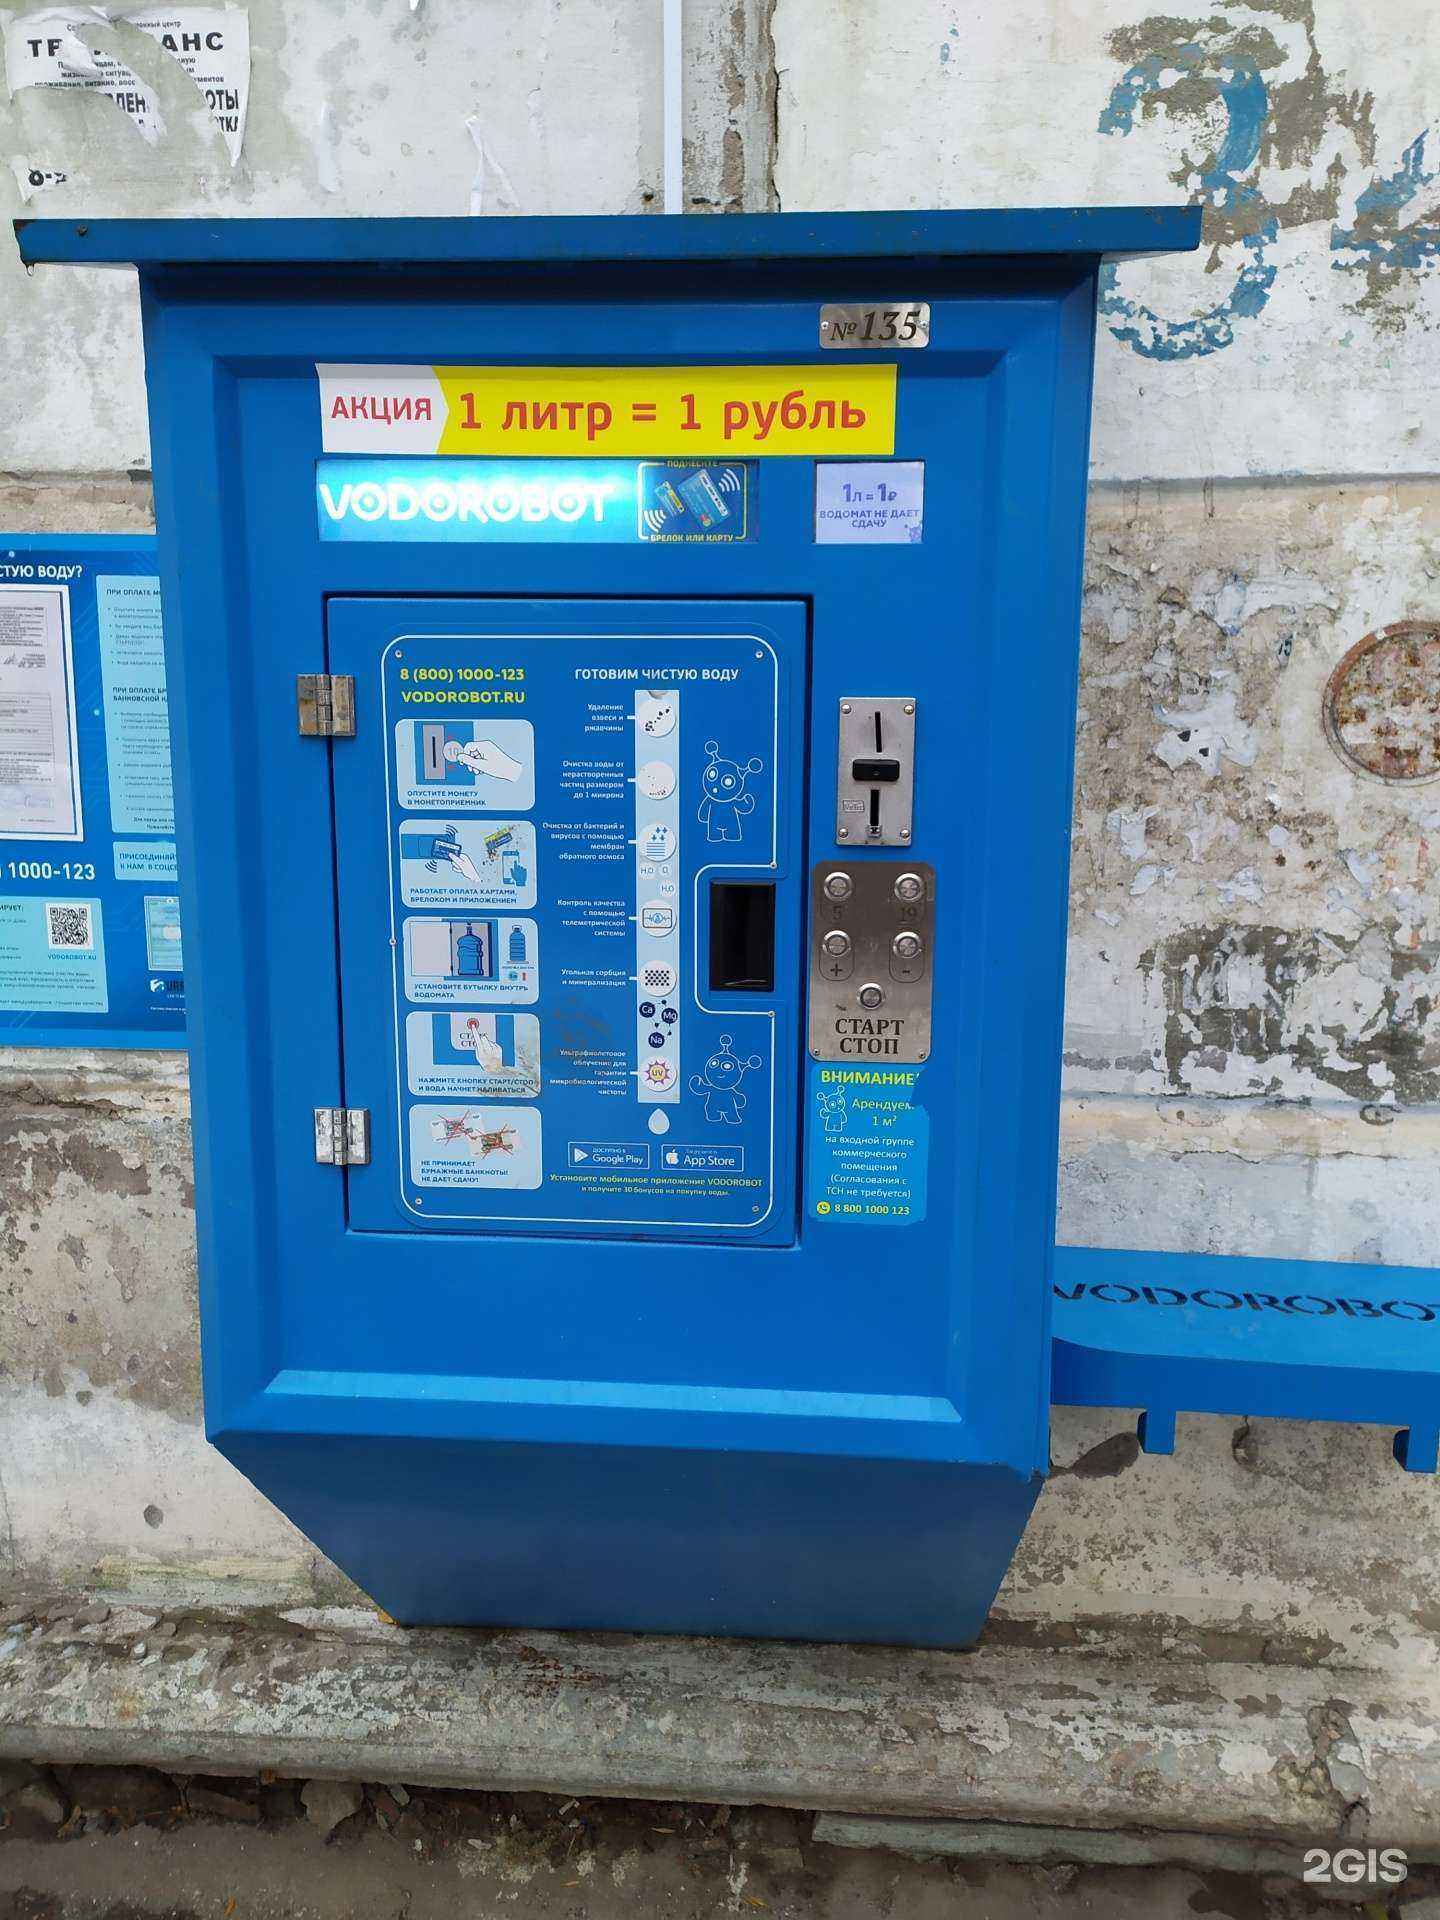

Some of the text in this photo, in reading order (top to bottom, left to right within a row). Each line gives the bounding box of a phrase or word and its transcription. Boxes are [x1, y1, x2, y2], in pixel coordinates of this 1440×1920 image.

[862, 311, 921, 342] 135
[331, 395, 432, 425] АКЦИЯ
[459, 392, 482, 430] 1
[501, 401, 613, 441] литр
[680, 393, 702, 430] 1
[723, 390, 867, 440] рубль
[319, 482, 615, 523] VODOROBOT
[819, 510, 920, 520] ВОДОМАТ НЕ ДАЕТ
[851, 519, 888, 529] СДАЧУ
[650, 534, 734, 543] БРЕЛОК ИЛИ КАРТУ
[38, 565, 83, 581] ВОДУ?
[400, 668, 525, 683] 8 (800) 1000-123
[575, 668, 740, 682] ГОТОВИМ ЧИСТУЮ ВОДУ
[402, 691, 527, 704] VODOROBOT.RU
[587, 703, 624, 712] Удаление
[562, 760, 593, 768] Очистка
[586, 781, 624, 789] размером
[407, 790, 479, 798] ОПУСТИТЕ МОНЕТУ
[573, 792, 584, 800] до
[414, 799, 487, 807] МОНЕТОПРИЕМНИК
[120, 853, 176, 862] ПРИСОЕДИНЯЙ
[559, 853, 597, 861] обратного
[8, 862, 97, 881] 1000-123
[561, 969, 595, 977] Угольная
[414, 983, 462, 991] УСТАНОВИТЕ
[641, 1006, 653, 1014] Ca
[663, 1012, 677, 1021] Mg
[835, 1018, 905, 1035] СТАРТ
[650, 1035, 663, 1044] Na
[839, 1037, 899, 1055] СТОП
[872, 1115, 880, 1126] 1
[825, 1136, 914, 1147] на входной группе
[592, 1154, 644, 1166] Google Play
[832, 1150, 907, 1159] коммерческого
[683, 1155, 735, 1167] App Store
[841, 1162, 898, 1172] помещения
[550, 1173, 763, 1187] Установите мобильное приложение VODOROBOT
[830, 1174, 900, 1185] (Согласования
[826, 1186, 844, 1196] ТСН
[860, 1189, 911, 1200] требуется)
[834, 1203, 910, 1215] 8 800 1000 123
[1052, 1282, 1440, 1322] VODOROBO
